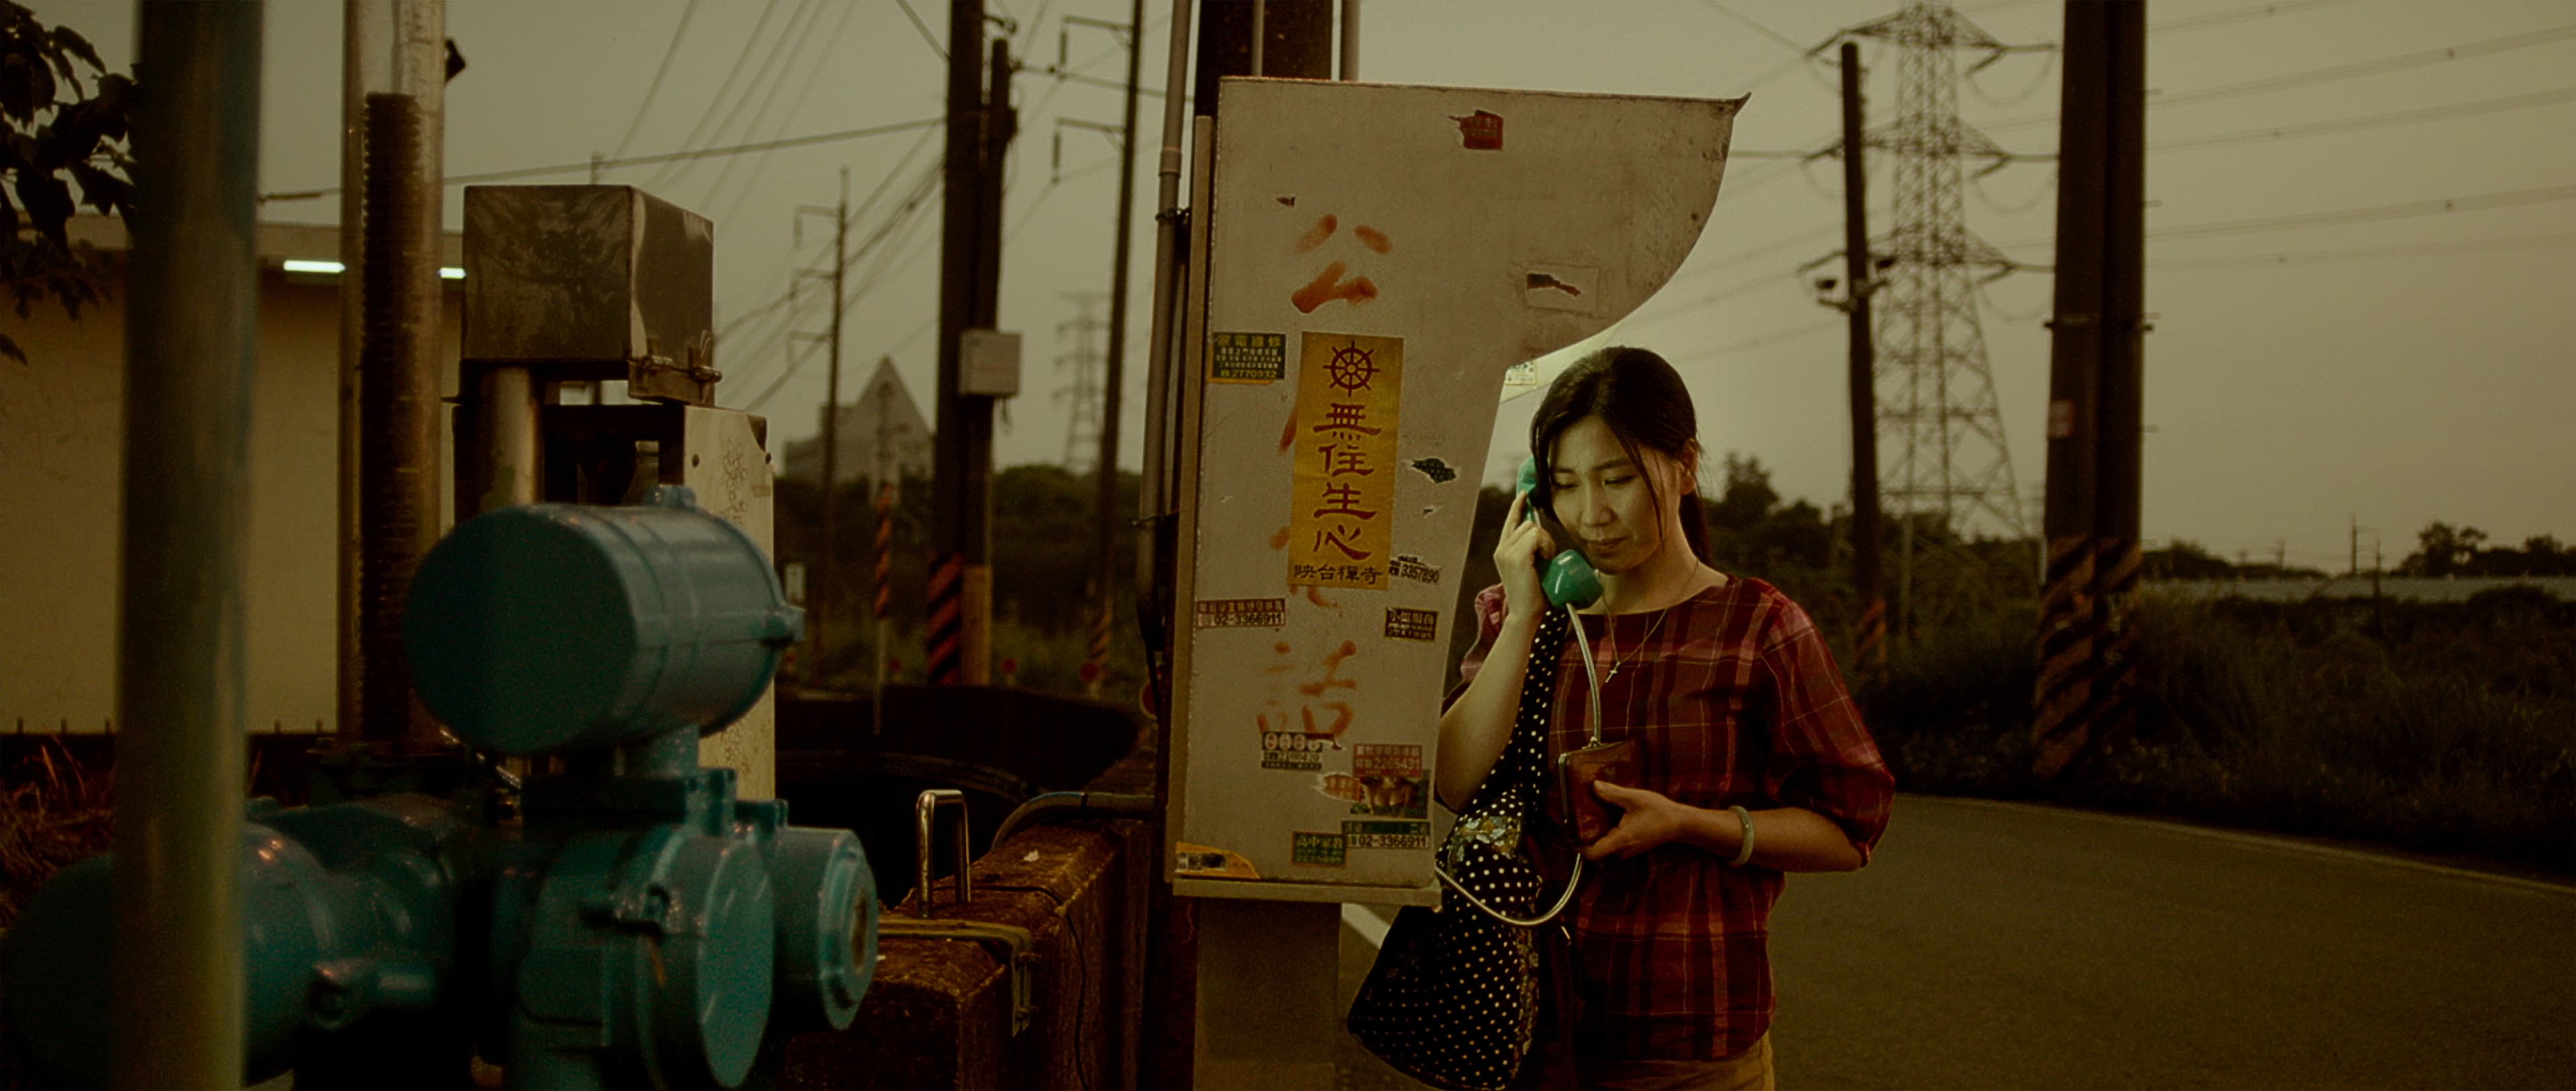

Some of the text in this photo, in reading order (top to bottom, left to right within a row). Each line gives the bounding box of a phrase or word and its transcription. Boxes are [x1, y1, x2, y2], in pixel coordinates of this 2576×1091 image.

[1313, 403, 1382, 560] 無住生心
[1358, 835, 1426, 847] 02-3366911
